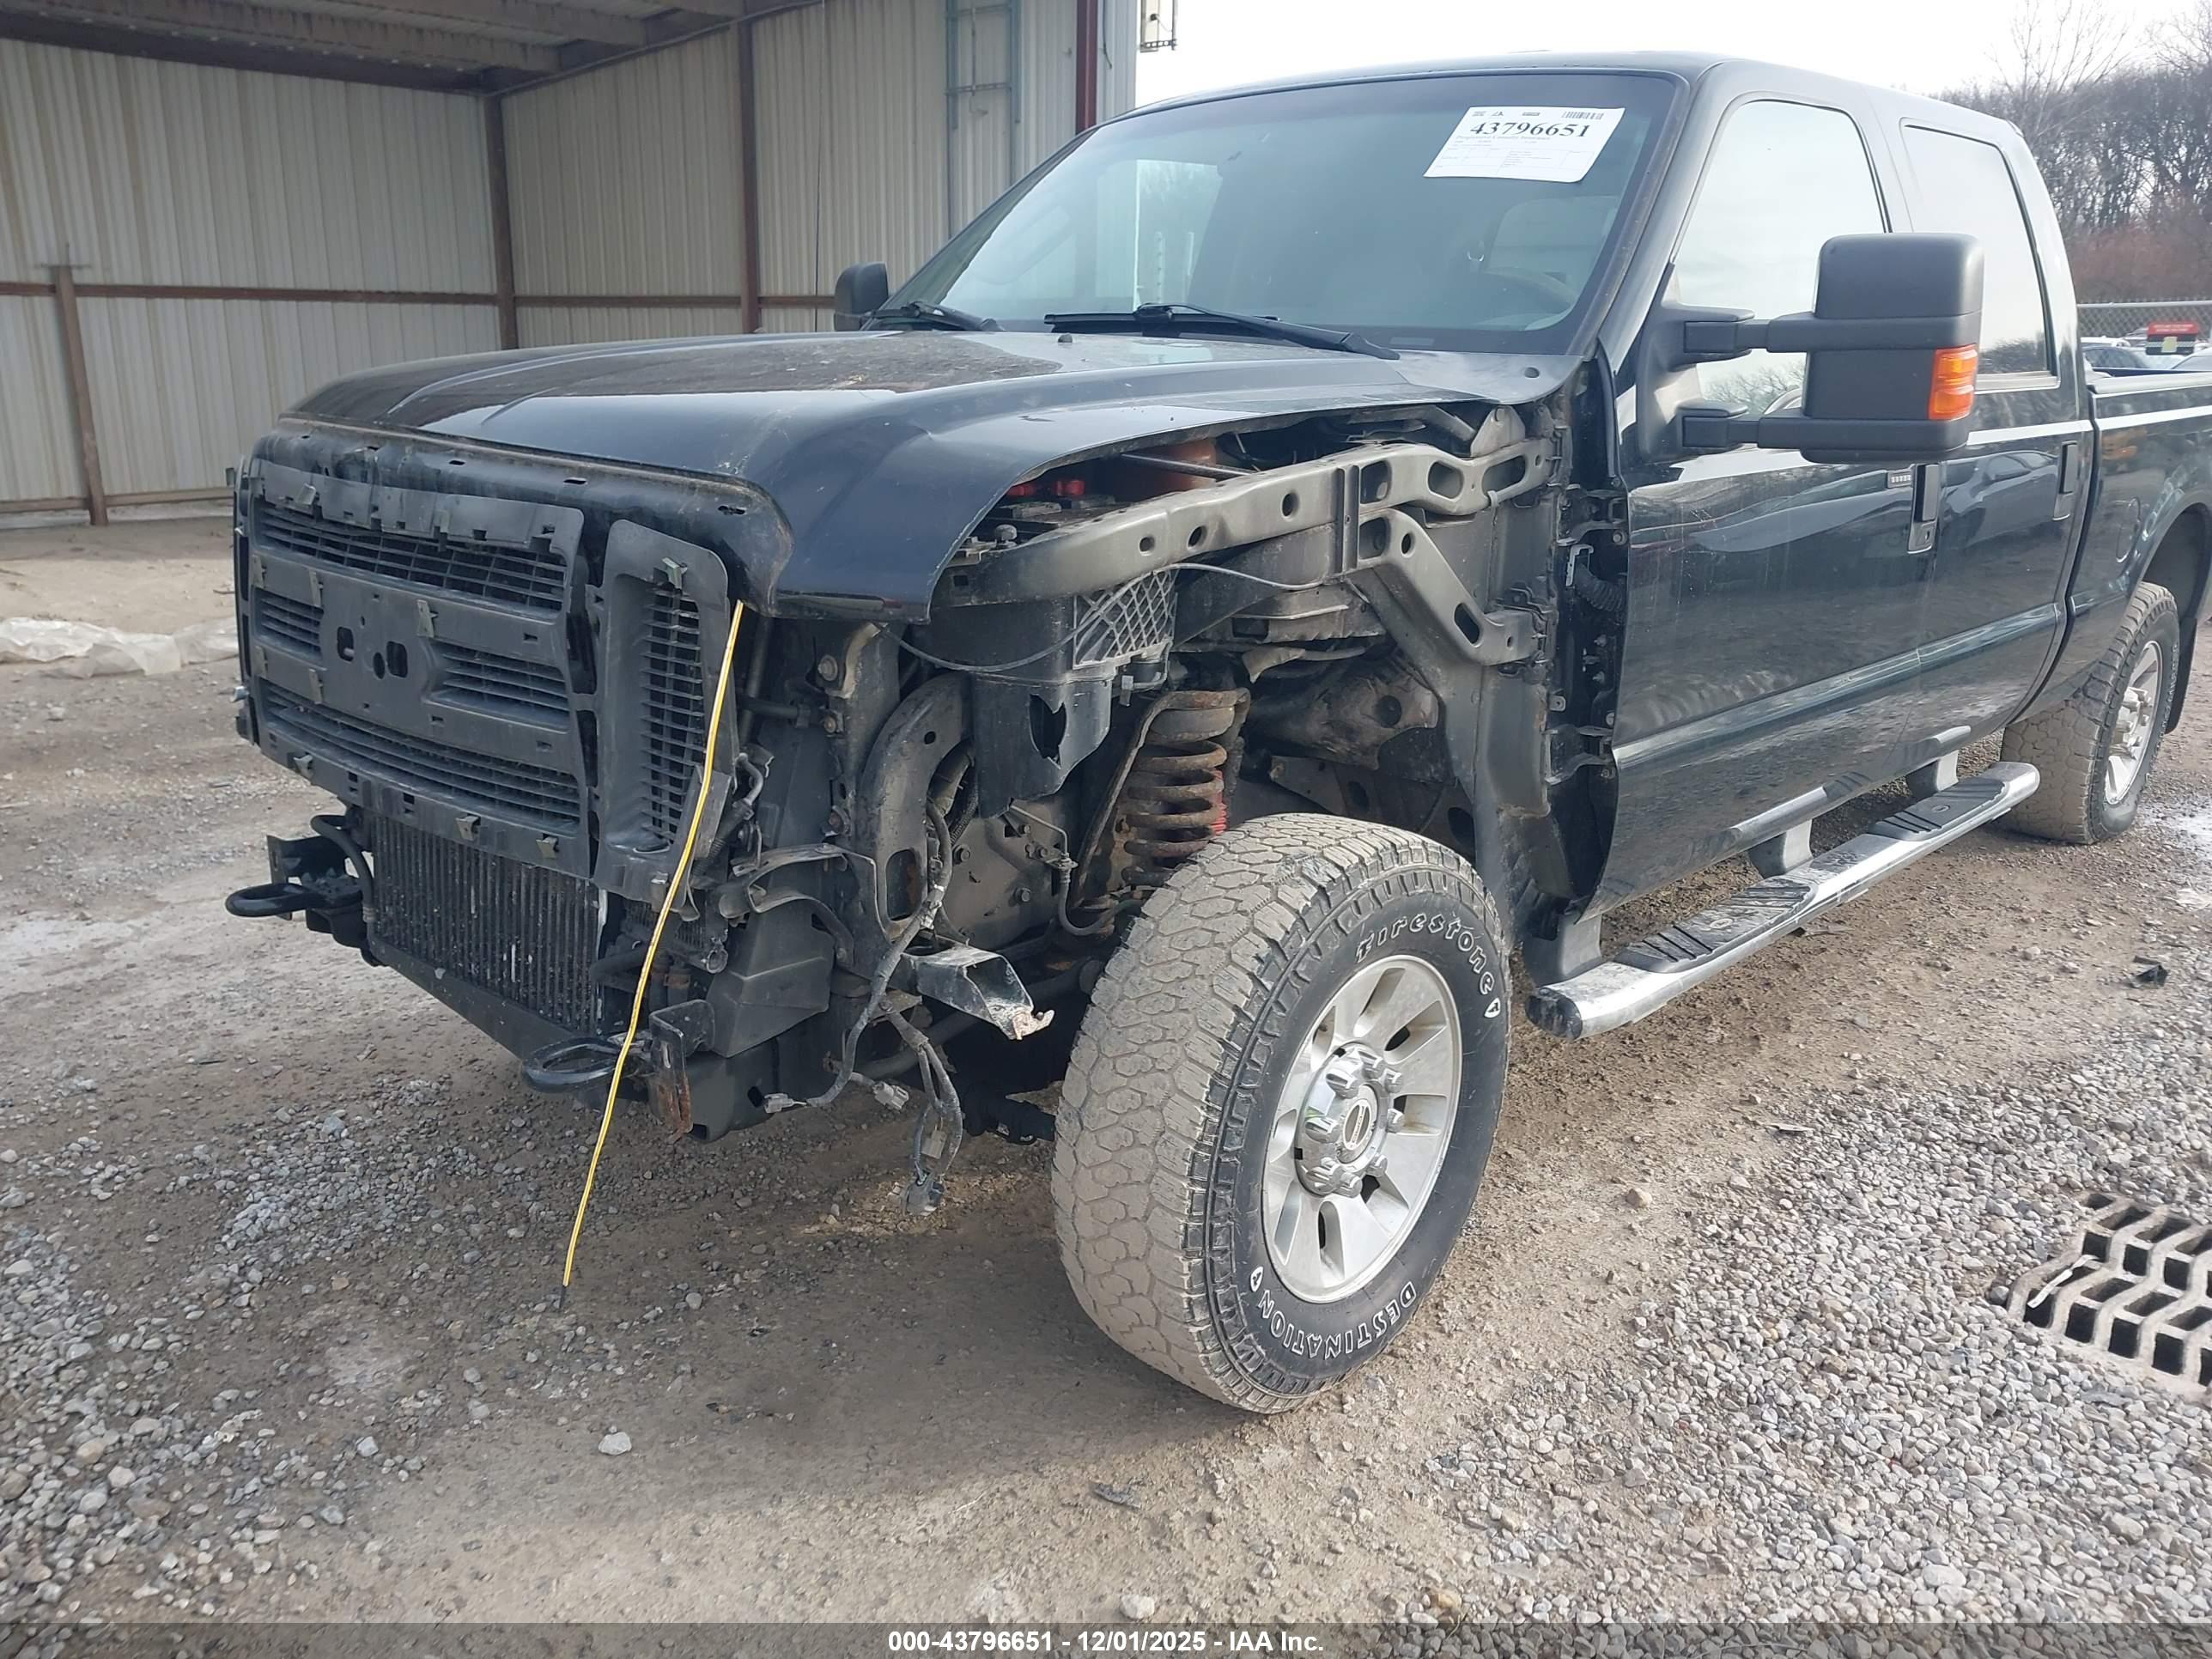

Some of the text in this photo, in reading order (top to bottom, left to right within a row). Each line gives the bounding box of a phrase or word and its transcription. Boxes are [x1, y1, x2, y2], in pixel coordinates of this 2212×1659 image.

[1469, 121, 1591, 137] 43796651
[1355, 911, 1496, 995] Firestone
[1257, 1280, 1418, 1360] DESTINATION
